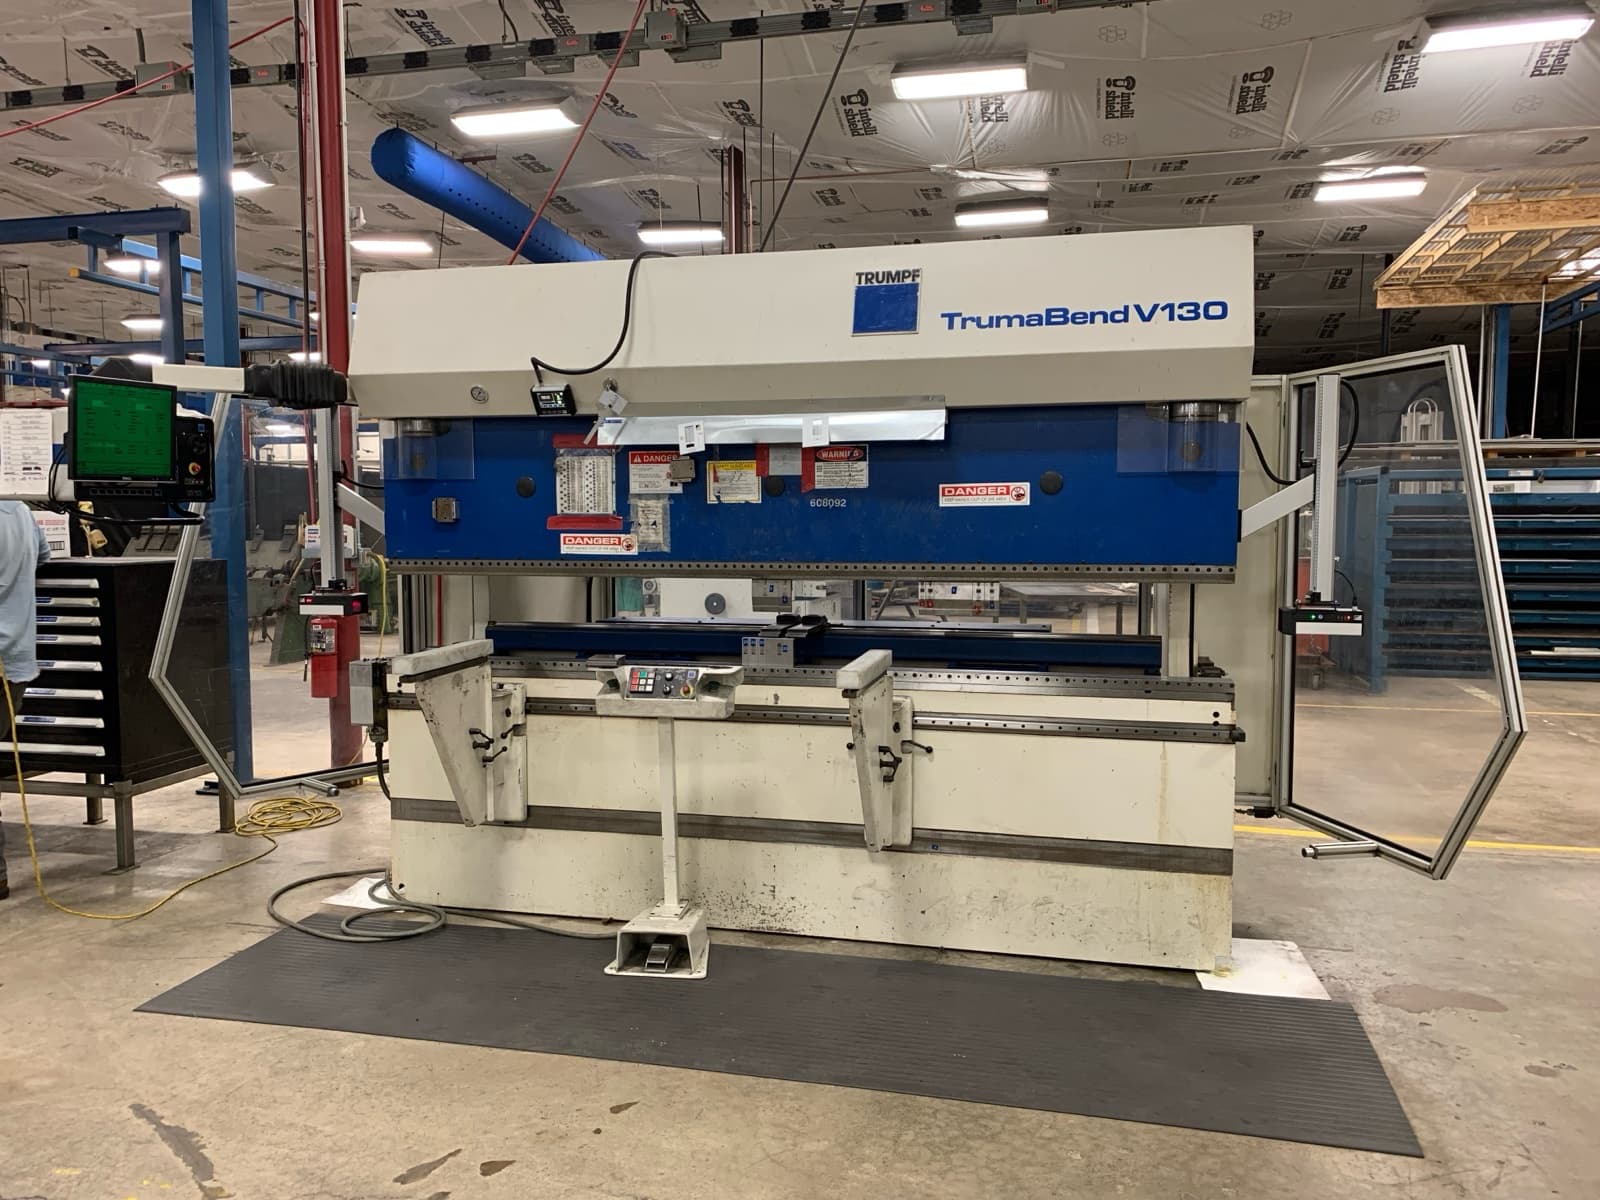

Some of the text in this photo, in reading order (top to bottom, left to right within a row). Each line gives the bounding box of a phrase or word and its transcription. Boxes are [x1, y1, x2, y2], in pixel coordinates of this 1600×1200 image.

[1400, 54, 1426, 89] intelli
[1548, 39, 1580, 76] intelli
[1384, 54, 1407, 93] shield
[1105, 90, 1120, 120] shield
[1120, 91, 1136, 119] intelli
[1235, 85, 1251, 115] shield
[1251, 84, 1272, 112] intelli
[843, 108, 865, 137] shield
[858, 108, 878, 136] intelli
[856, 269, 920, 285] TRUMPF
[940, 301, 1228, 331] TrumaBend V130
[810, 498, 847, 508] 608092
[944, 486, 1007, 496] DANGER
[565, 537, 619, 545] DANGER
